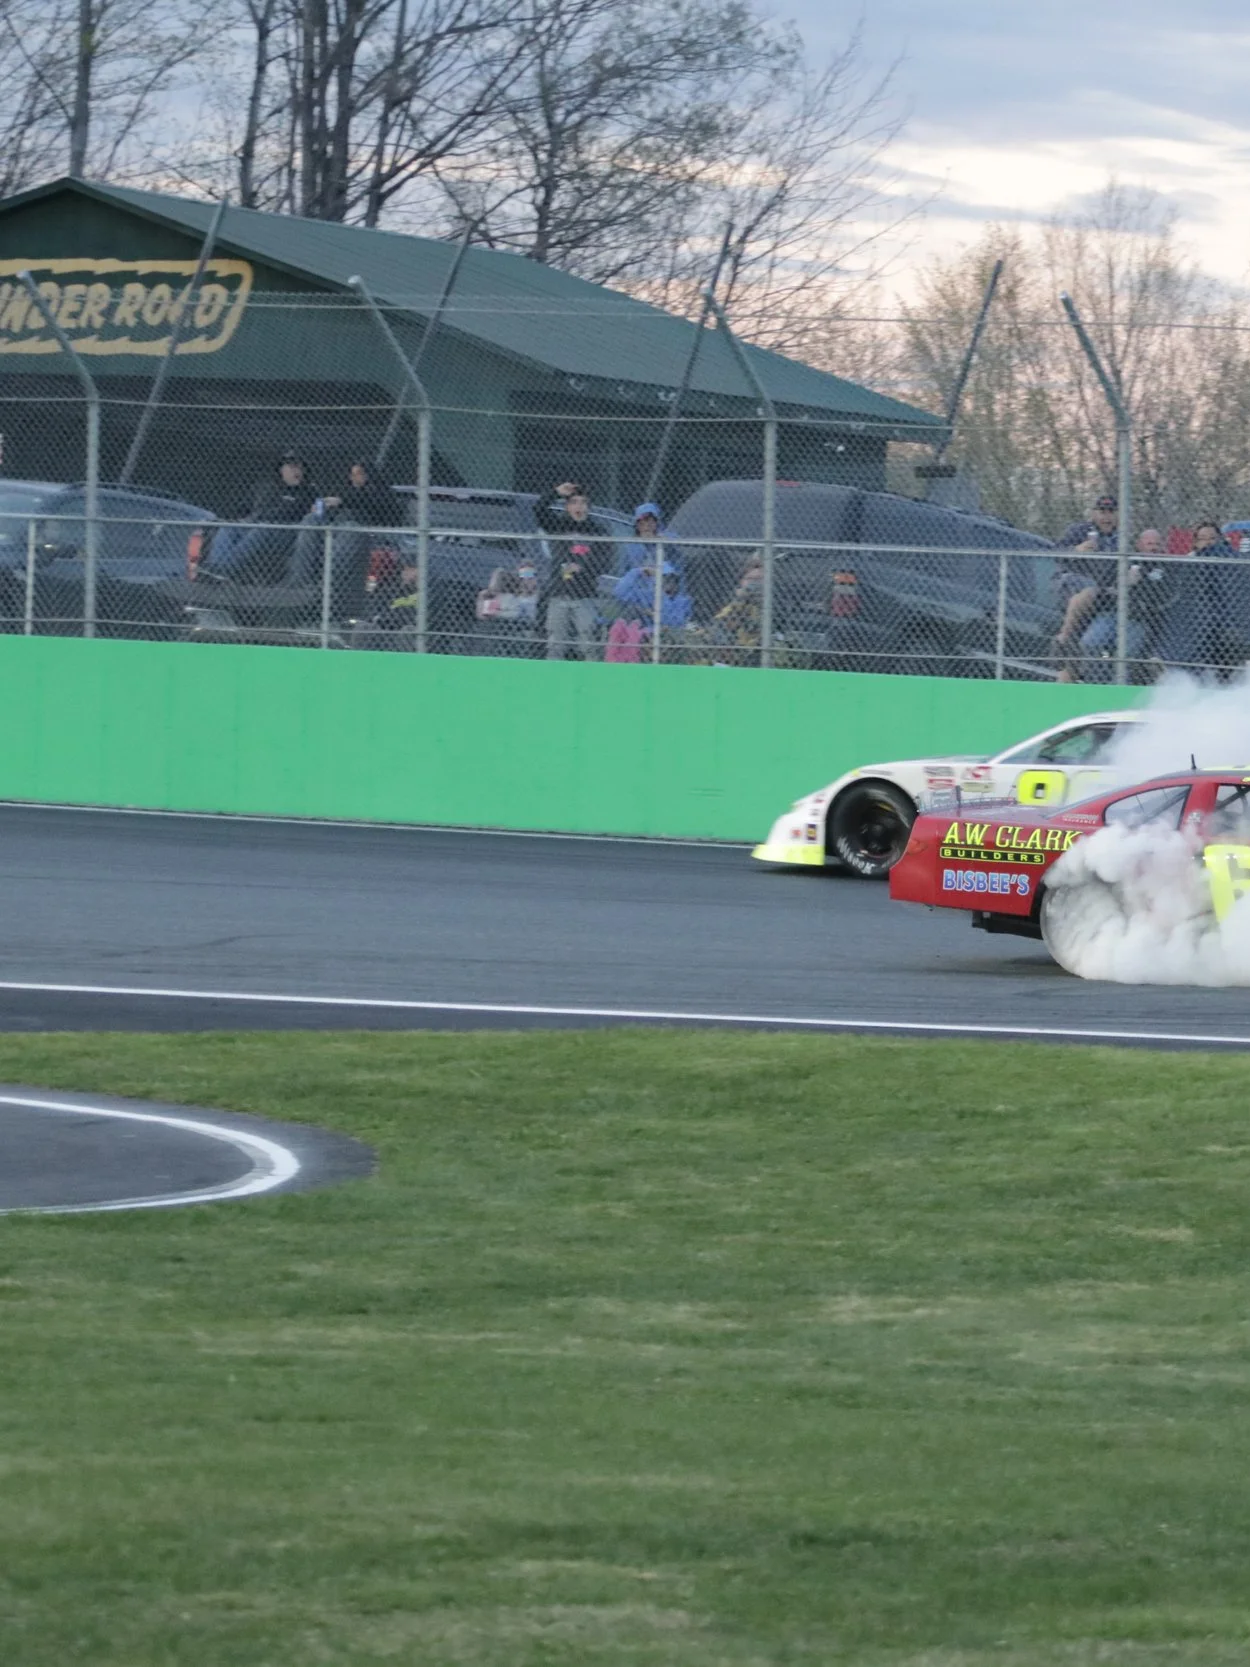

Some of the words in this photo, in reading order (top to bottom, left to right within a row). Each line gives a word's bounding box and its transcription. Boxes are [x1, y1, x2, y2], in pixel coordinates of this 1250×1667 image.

[113, 282, 229, 328] ROAD
[995, 825, 1084, 851] CLARK
[943, 848, 1042, 864] BUILDERS
[943, 869, 1030, 895] BISBEE'S
